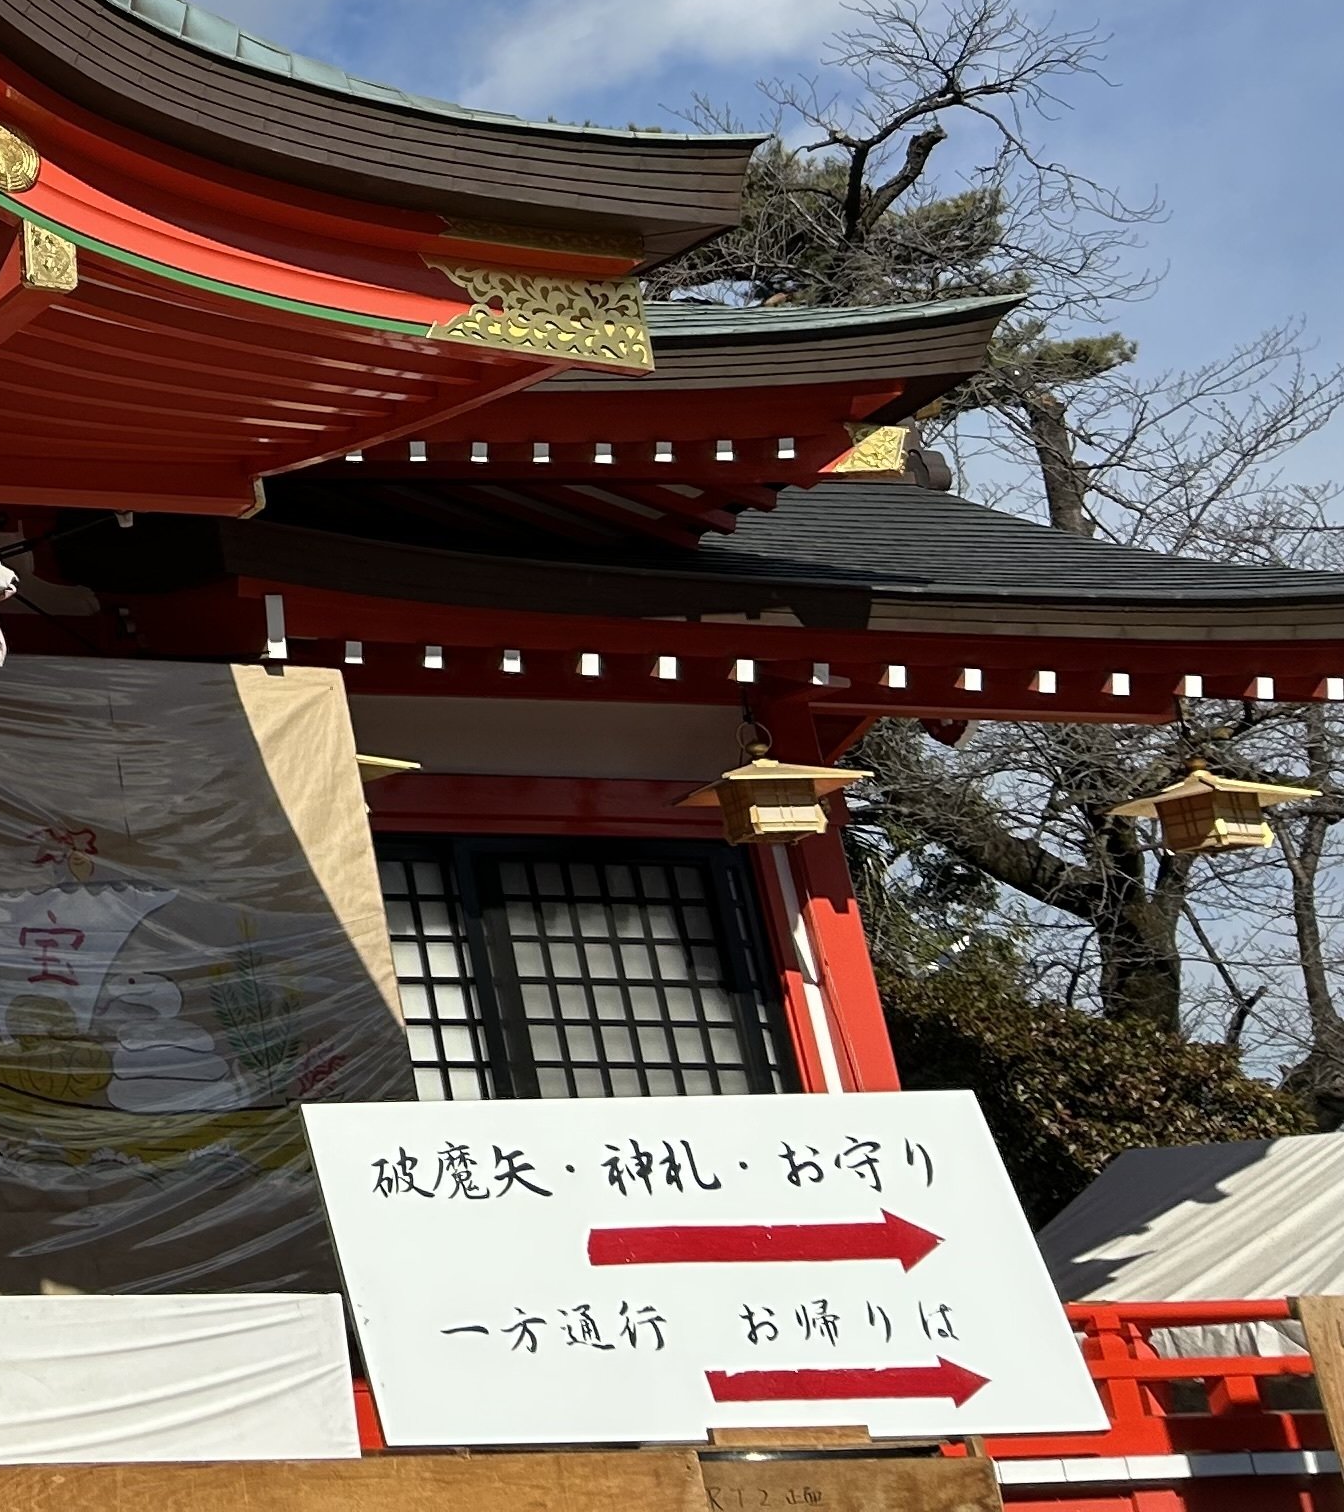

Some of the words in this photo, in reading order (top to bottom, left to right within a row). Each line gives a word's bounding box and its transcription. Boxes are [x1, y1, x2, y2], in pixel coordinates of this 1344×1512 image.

[19, 910, 86, 986] 宝
[440, 1301, 668, 1354] 一方通行
[739, 1299, 962, 1347] お帰りは
